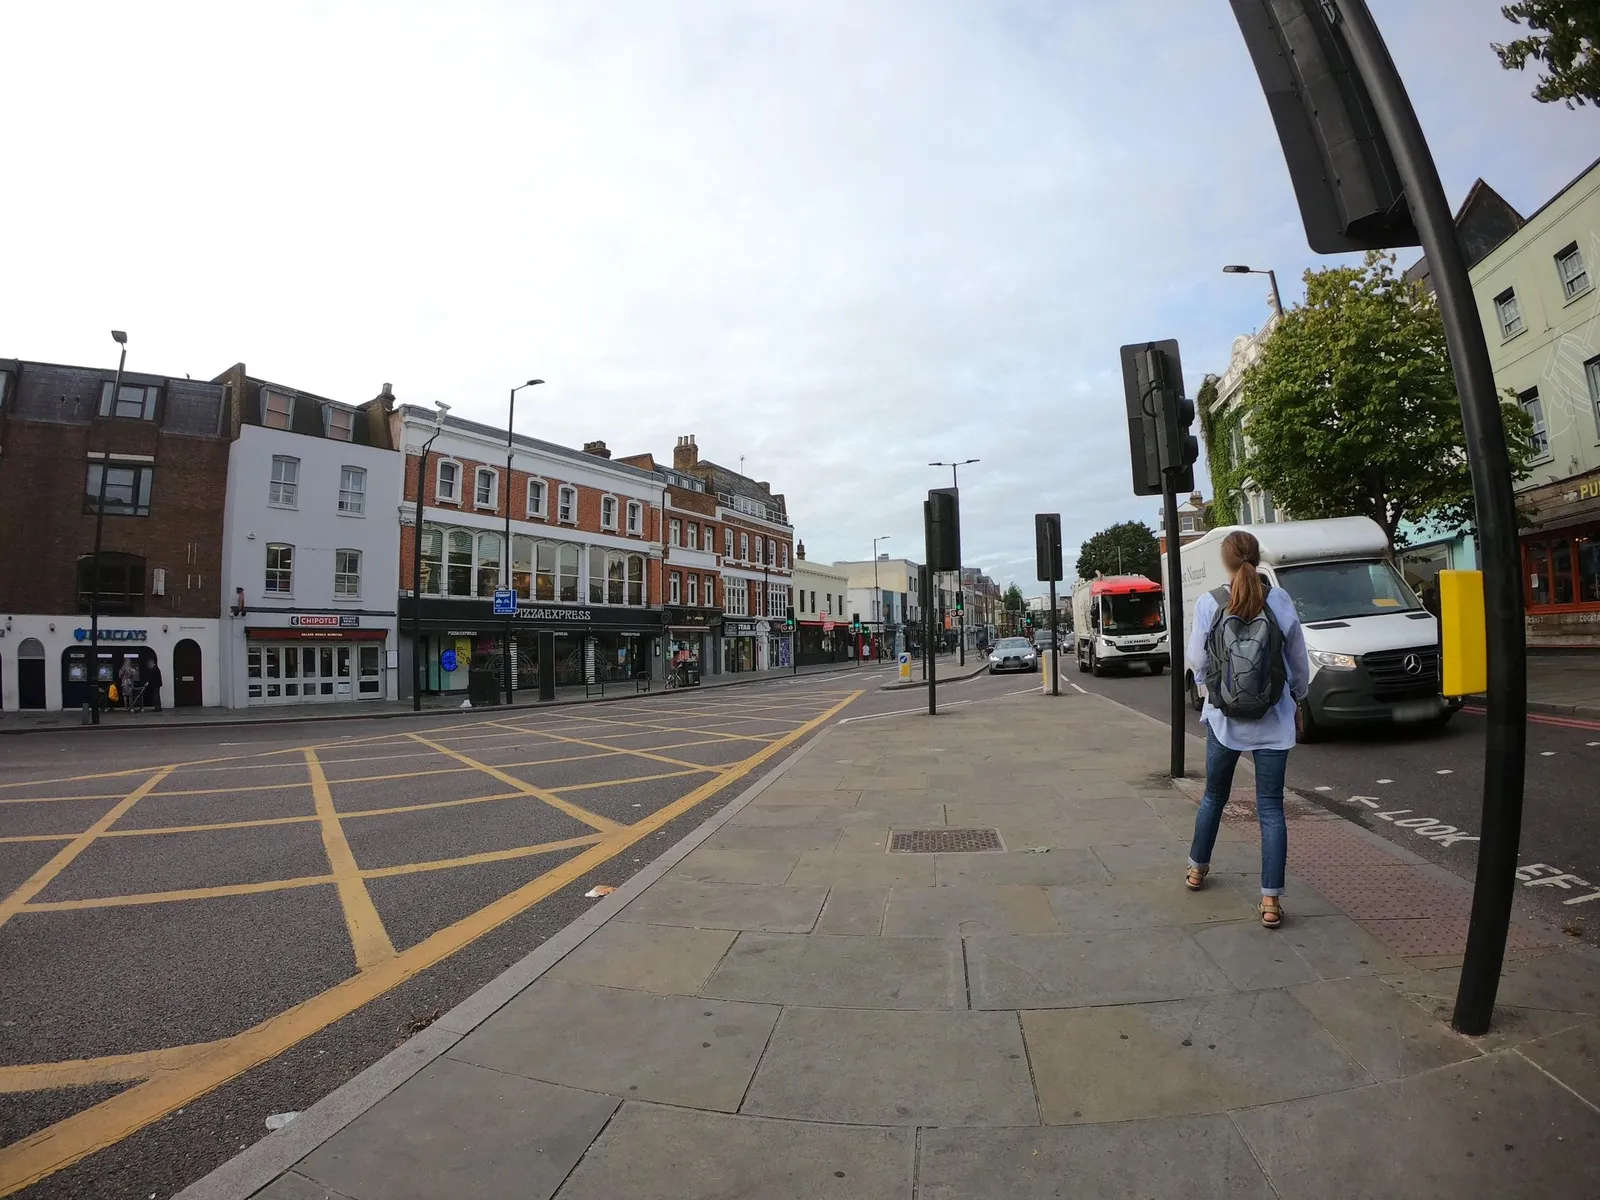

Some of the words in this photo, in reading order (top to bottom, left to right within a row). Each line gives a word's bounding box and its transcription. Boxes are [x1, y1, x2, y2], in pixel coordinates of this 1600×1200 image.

[1580, 481, 1600, 499] PU
[1187, 561, 1206, 581] Natural
[512, 608, 591, 620] PIZZAEXPRESS
[1374, 809, 1480, 848] LOOK
[1516, 863, 1600, 905] EFT
